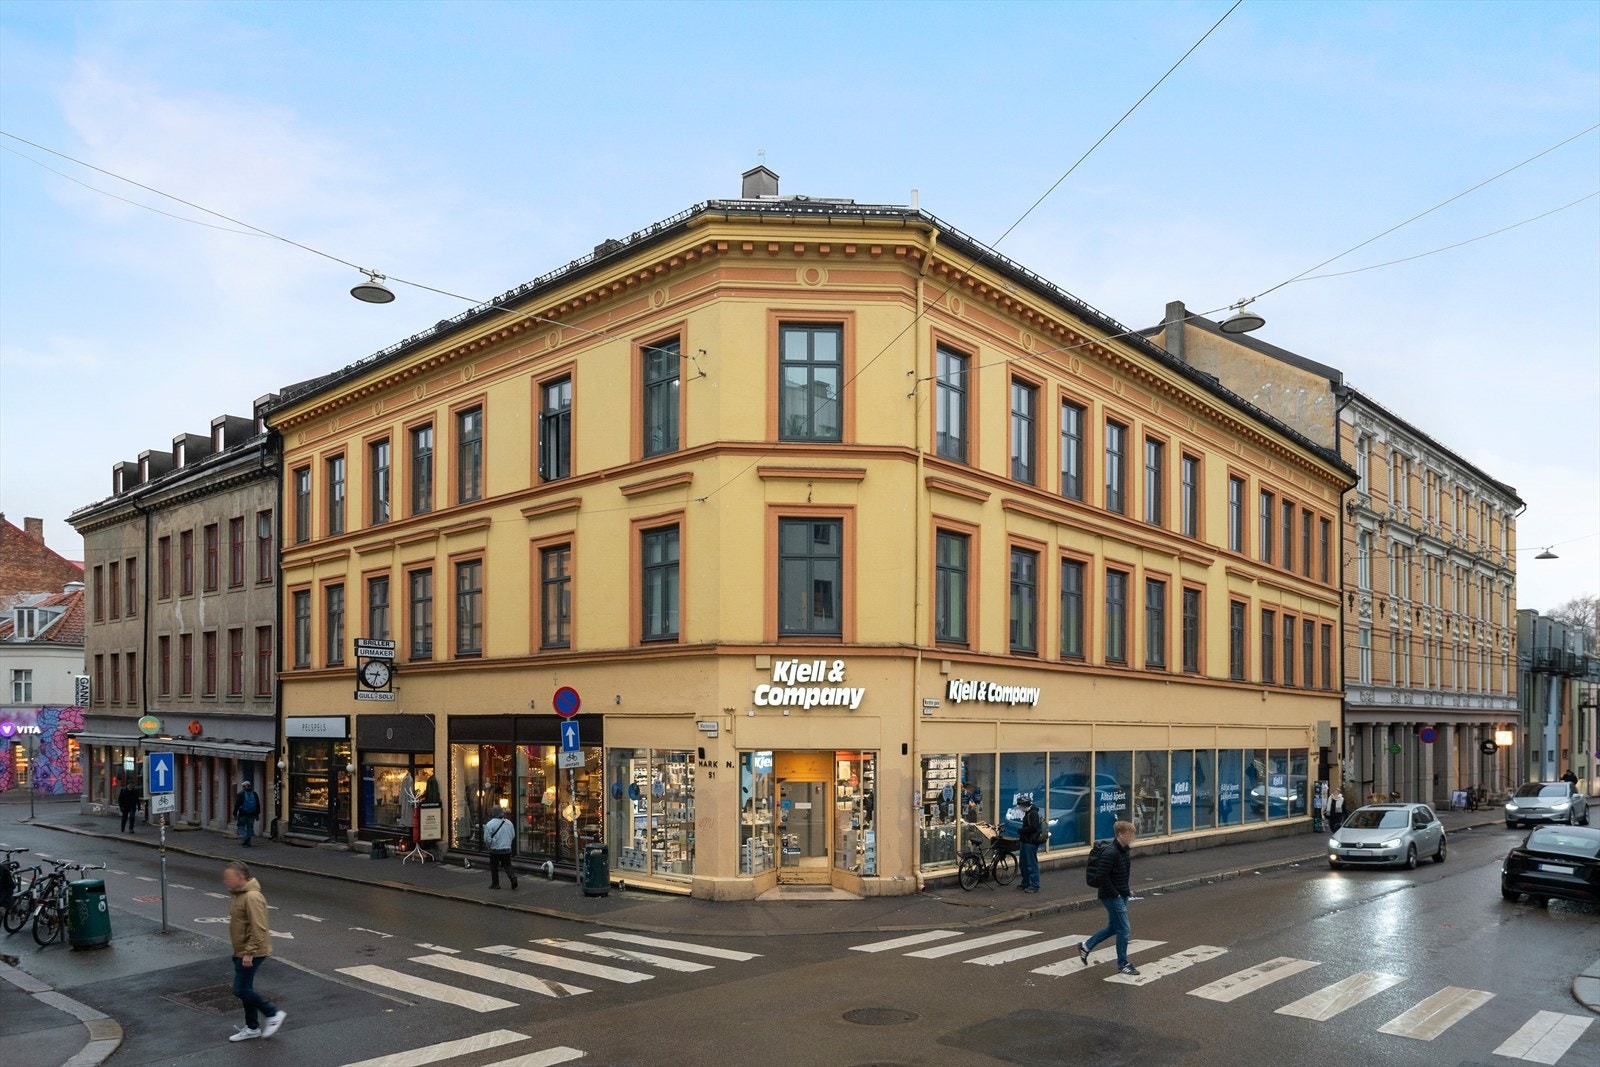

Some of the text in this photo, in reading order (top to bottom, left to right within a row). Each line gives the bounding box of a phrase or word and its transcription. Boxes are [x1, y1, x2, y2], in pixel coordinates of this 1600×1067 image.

[360, 648, 393, 656] URMAKER
[773, 659, 845, 686] Kjell &
[80, 677, 89, 706] GANNI
[754, 684, 865, 710] Company
[949, 679, 1040, 706] Kjell & Company
[302, 724, 326, 732] PELSPELS
[1175, 782, 1185, 794] Kjell
[1100, 791, 1126, 801] Alltid åpent
[1171, 794, 1191, 805] Company
[1100, 802, 1126, 813] på kjell.com
